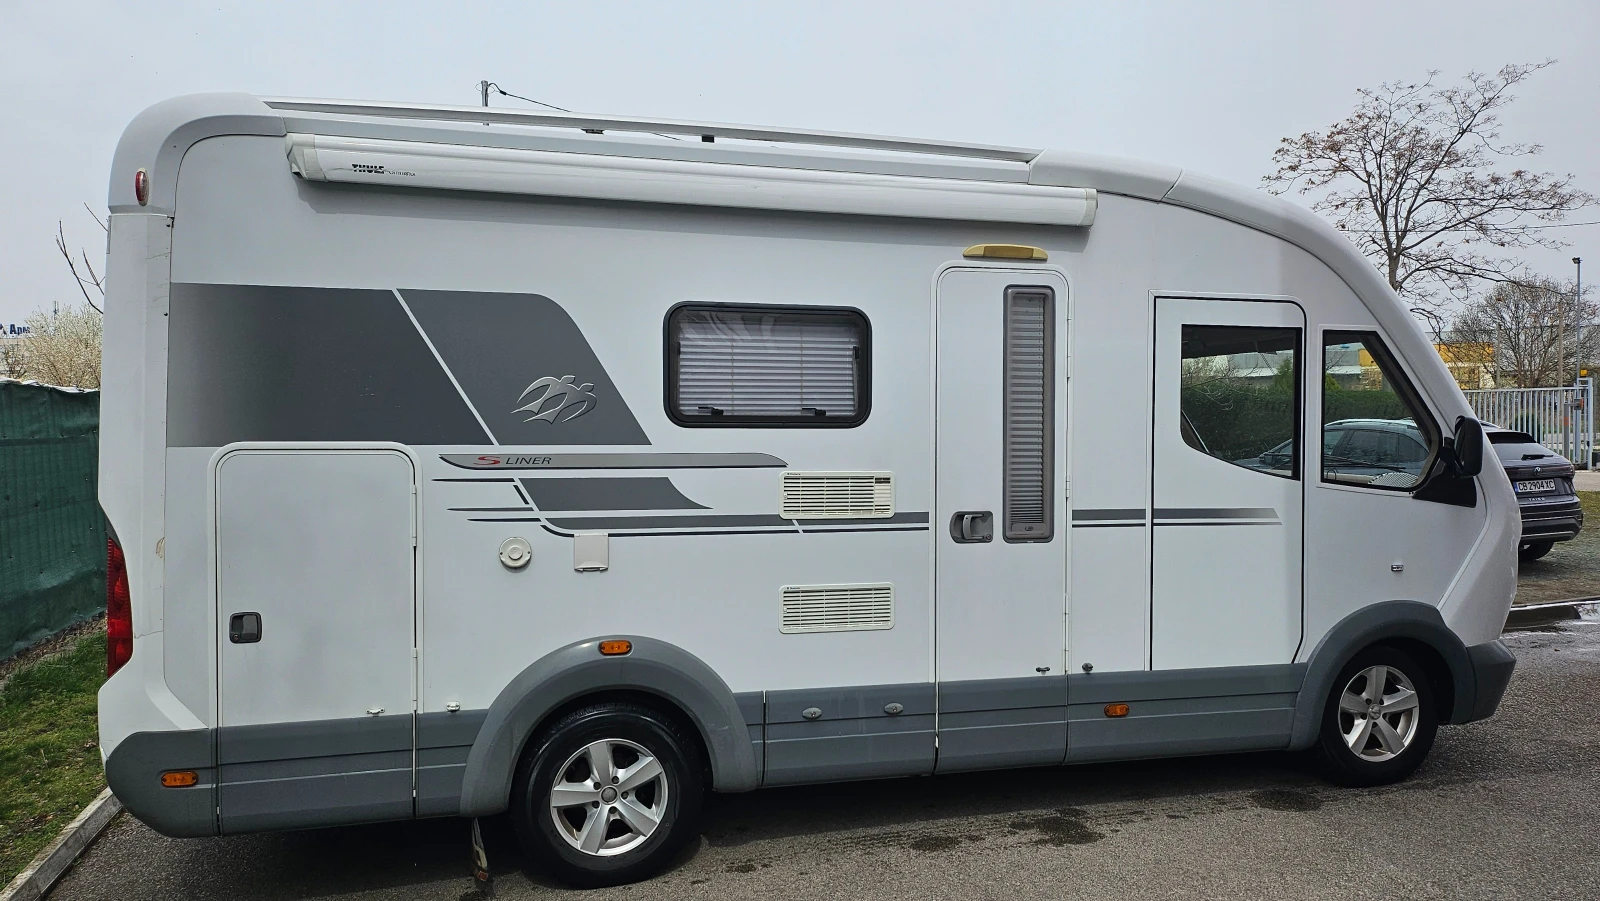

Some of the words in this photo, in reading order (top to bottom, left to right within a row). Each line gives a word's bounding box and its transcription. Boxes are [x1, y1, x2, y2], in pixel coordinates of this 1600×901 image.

[352, 163, 384, 174] THULE
[473, 456, 500, 466] S
[505, 457, 552, 465] LINER
